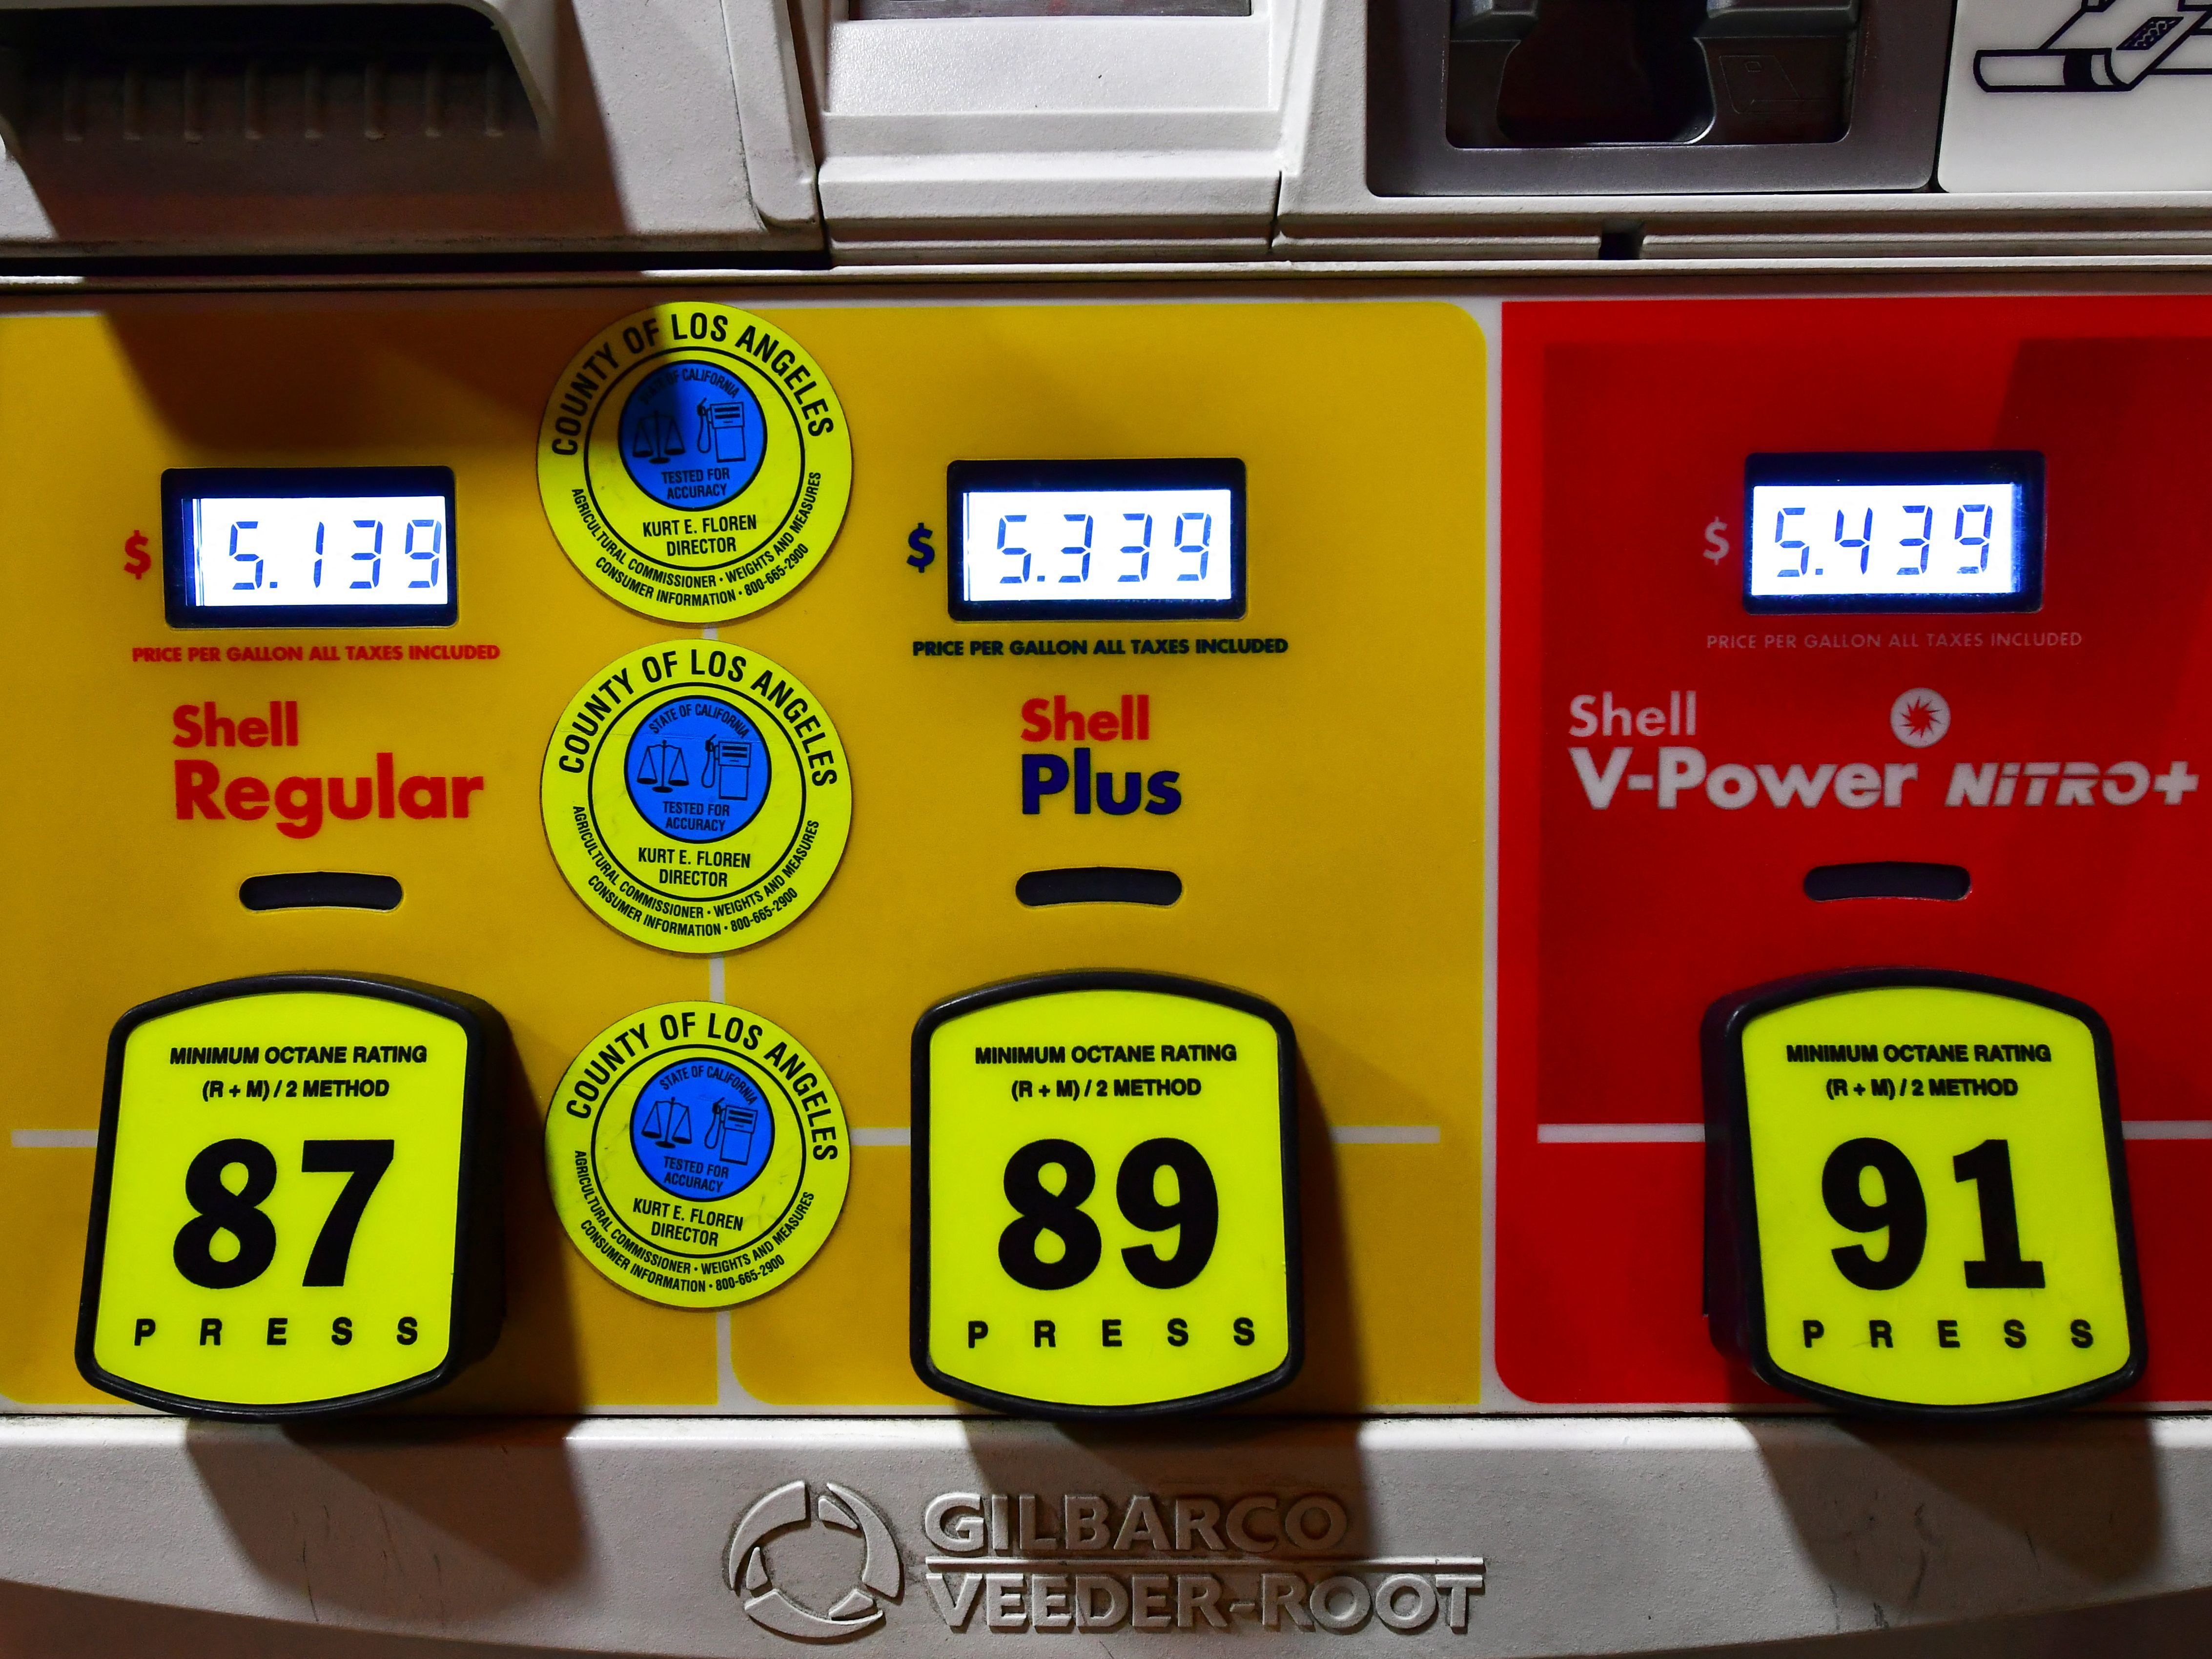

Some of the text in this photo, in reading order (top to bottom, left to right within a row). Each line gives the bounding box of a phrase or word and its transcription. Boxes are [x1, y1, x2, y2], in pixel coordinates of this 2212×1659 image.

[551, 311, 834, 455] COUNTY OF LOS ANGELES
[666, 369, 679, 385] OF
[682, 368, 740, 399] CALIFORNIA
[661, 467, 730, 484] TESTED FOR
[666, 483, 727, 500] ACCURACY
[571, 471, 821, 588] AGRICULTURAL COMMISSIONER WEIGHTS AND MEASURES
[642, 514, 757, 537] KURT E. FLOREN
[1702, 504, 1993, 577] $ 5.439
[123, 519, 442, 590] $ 5.139
[666, 537, 737, 556] DIRECTOR
[906, 512, 1213, 584] $ 5.339
[595, 543, 809, 607] CONSUMER INFORMATION 800-665-2900
[132, 644, 500, 663] PRICE PER GALLON ALL TAXES INCLUDED
[912, 638, 1289, 656] PRICE PER GALLON ALL TAXES INCLUDED
[1706, 632, 2082, 649] PRICE PER GALLON ALL TAXES INCLUDED
[172, 700, 299, 748] Shell
[559, 648, 838, 787] COUNTY OF LOS ANGELES
[648, 702, 750, 739] STATE OF CALIFORNIA
[1020, 694, 1149, 742] Shell
[1568, 690, 1697, 738] Shell
[174, 752, 484, 840] Regular
[1022, 747, 1182, 815] Plus
[1567, 746, 1919, 810] V-Power
[662, 801, 730, 817] TESTED FOR
[665, 816, 726, 832] ACCURACY
[573, 805, 820, 919] AGRICULTURAL COMMISSIONER WEIGHTS AND MEASURES
[638, 847, 751, 869] KURT E. FLOREN
[659, 868, 728, 887] DIRECTOR
[588, 875, 798, 937] CONSUMER INFORMATION 800-665-2900
[170, 1045, 427, 1065] MINIMUM OCTANE RATING
[975, 1044, 1237, 1065] MINIMUM OCTANE RATING
[1786, 1044, 2052, 1063] MINIMUM OCTANE RATING
[303, 1079, 389, 1098] METHOD
[566, 1011, 839, 1161] COUNTY OF LOS ANGELES
[659, 1065, 758, 1106] STATE OF CALIFORNIA
[1113, 1079, 1202, 1097] METHOD
[1929, 1078, 2019, 1096] METHOD
[663, 1156, 730, 1179] TESTED FOR
[664, 1175, 723, 1193] ACCURACY
[173, 1138, 395, 1290] 87
[574, 1149, 815, 1275] AGRICULTURAL COMMISSIONER WEIGHTS AND MEASURES
[633, 1197, 744, 1231] KURT E. FLOREN
[998, 1137, 1219, 1290] 89
[1822, 1137, 2046, 1290] 91
[651, 1221, 719, 1247] DIRECTOR
[580, 1219, 786, 1292] CONSUMER INFORMATION 800-665-2900
[924, 1493, 1349, 1553] GILBARCO
[925, 1572, 1483, 1634] VEEDER-ROOT
